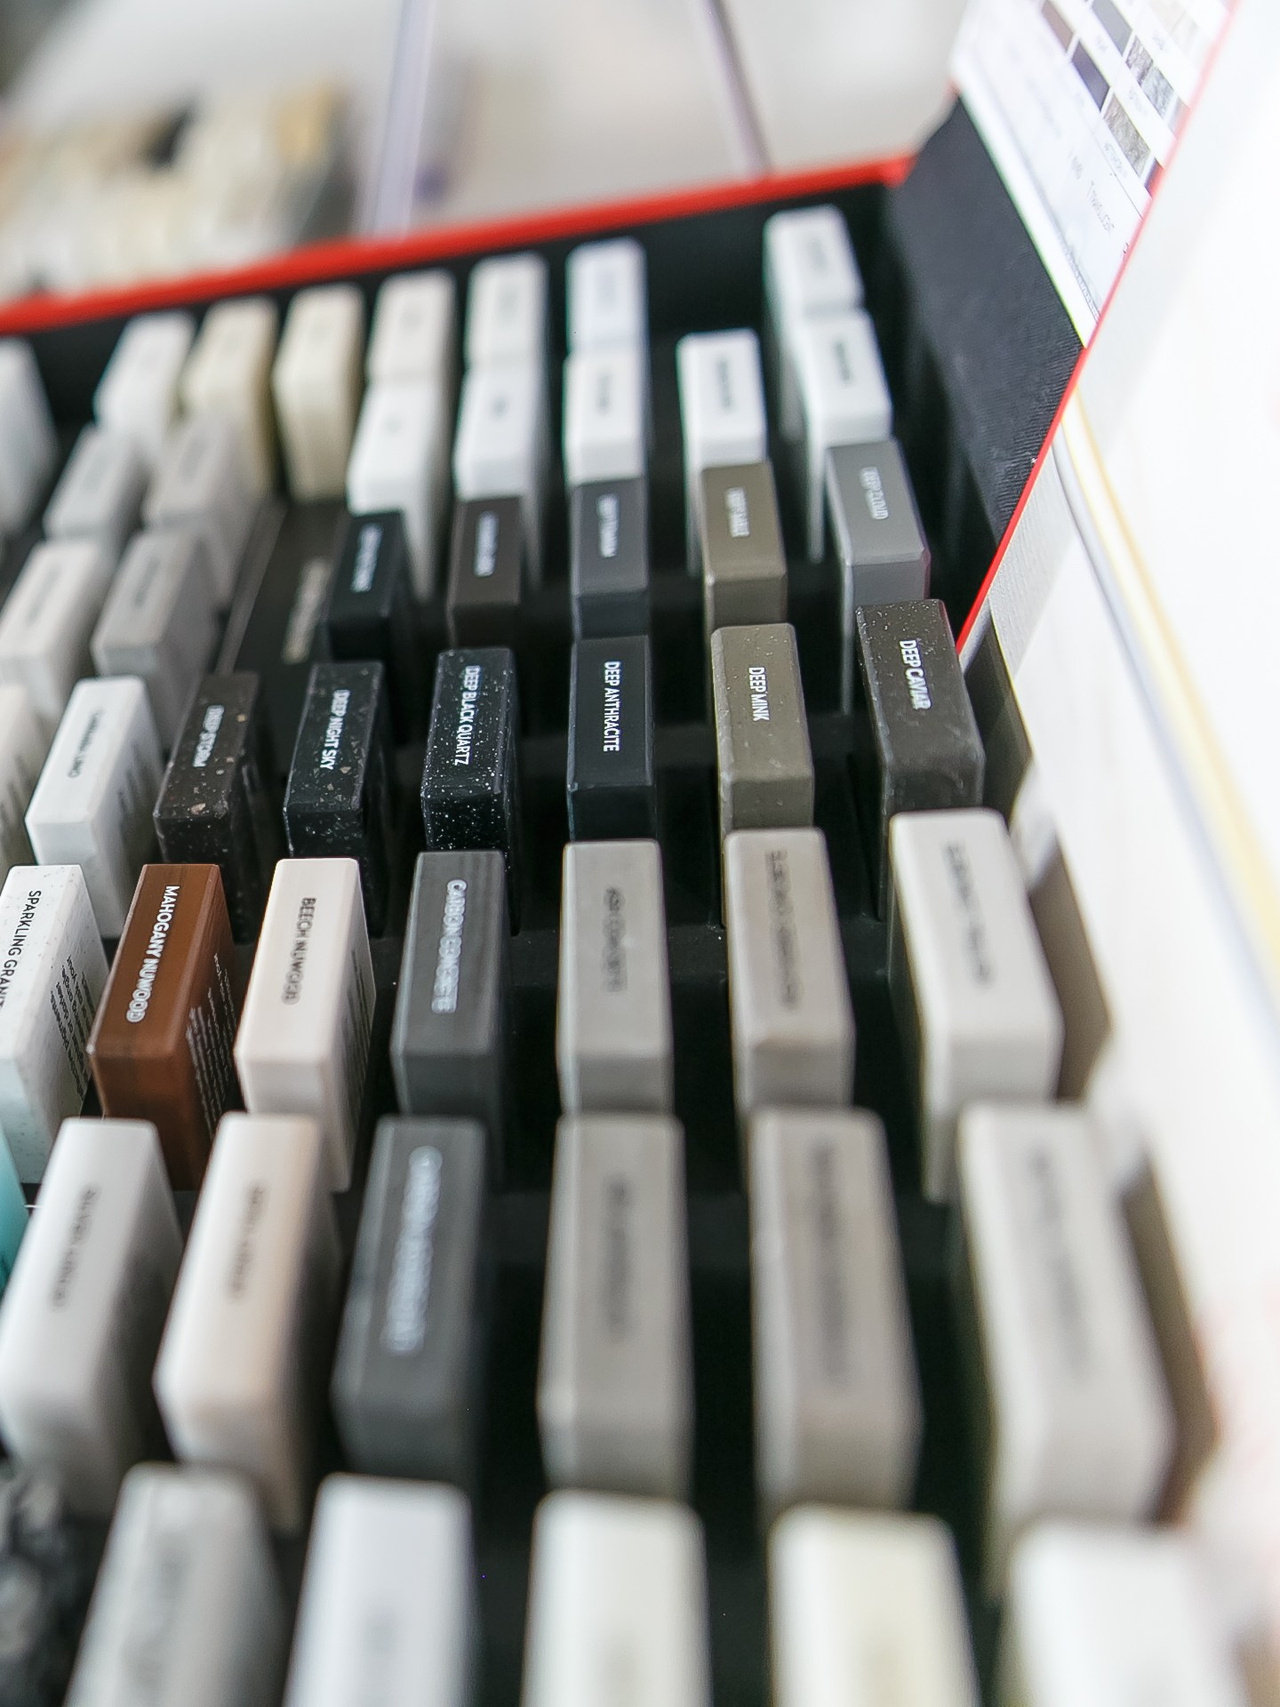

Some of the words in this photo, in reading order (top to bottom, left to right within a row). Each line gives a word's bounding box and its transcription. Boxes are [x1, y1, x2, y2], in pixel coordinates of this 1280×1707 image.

[900, 639, 919, 668] DEEP
[463, 665, 481, 692] DEEP
[604, 661, 621, 687] DEEP
[749, 667, 766, 693] DEEP
[905, 667, 932, 710] CAVIAR
[458, 692, 478, 724] BLACK
[603, 687, 620, 752] ANTHRACITE
[752, 692, 770, 722] MINK
[325, 716, 343, 750] NIGHT
[454, 723, 473, 766] QUARTZ
[320, 748, 340, 771] SKY
[7, 889, 42, 957] SPARKLING
[145, 886, 180, 957] MAHOGANY
[294, 897, 317, 938] BEECH
[126, 953, 158, 1023] NUWOOD
